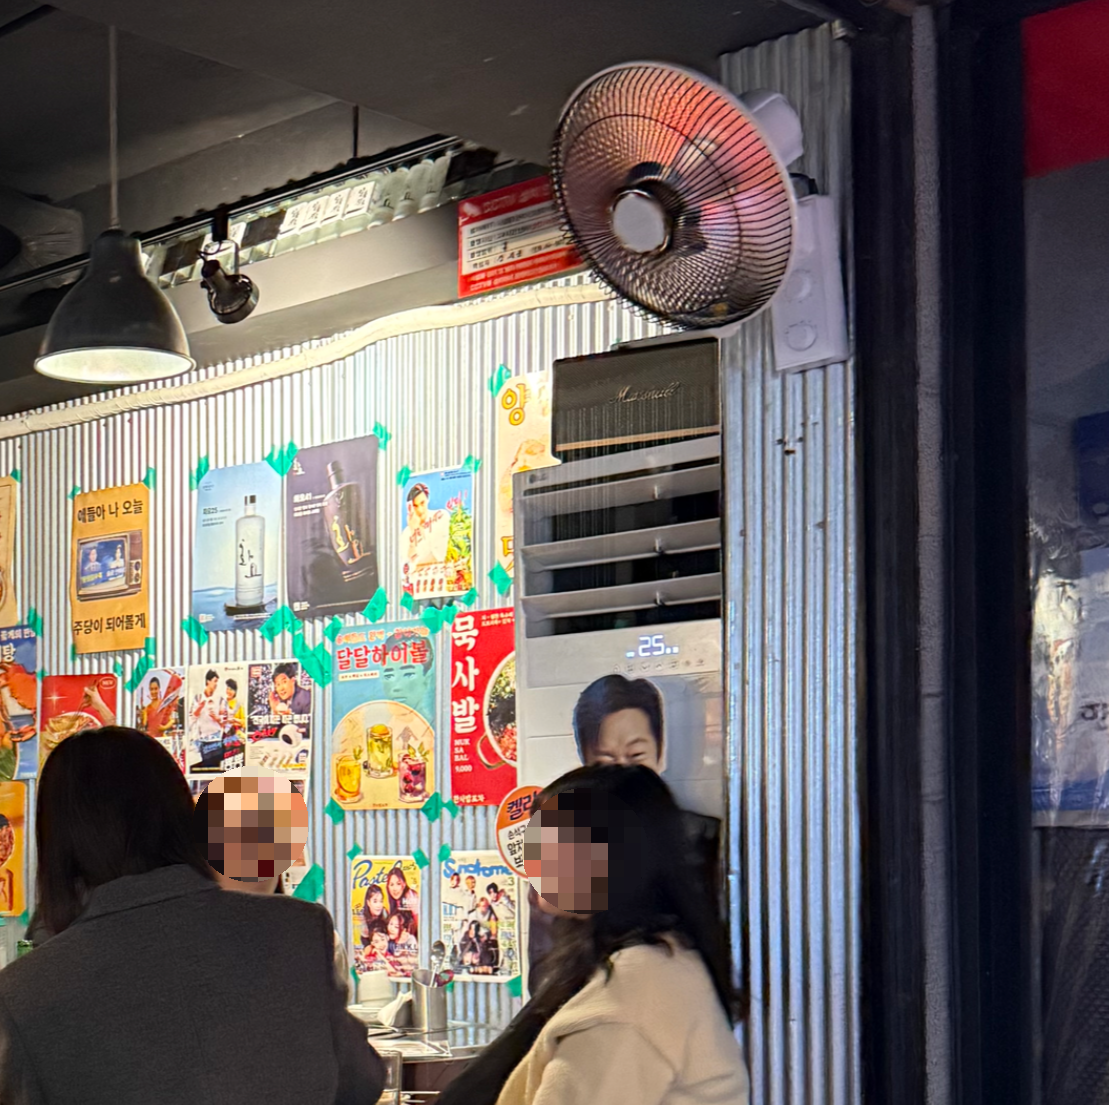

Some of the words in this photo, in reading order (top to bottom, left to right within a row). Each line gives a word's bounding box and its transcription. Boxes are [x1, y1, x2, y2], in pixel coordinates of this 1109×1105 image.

[108, 502, 119, 518] 나
[122, 498, 143, 516] 오늘
[73, 617, 104, 636] 주당이
[106, 612, 146, 632] 되어볼게
[336, 639, 430, 671] 달달하이볼
[638, 635, 665, 657] 25
[451, 614, 479, 734] 묵사발
